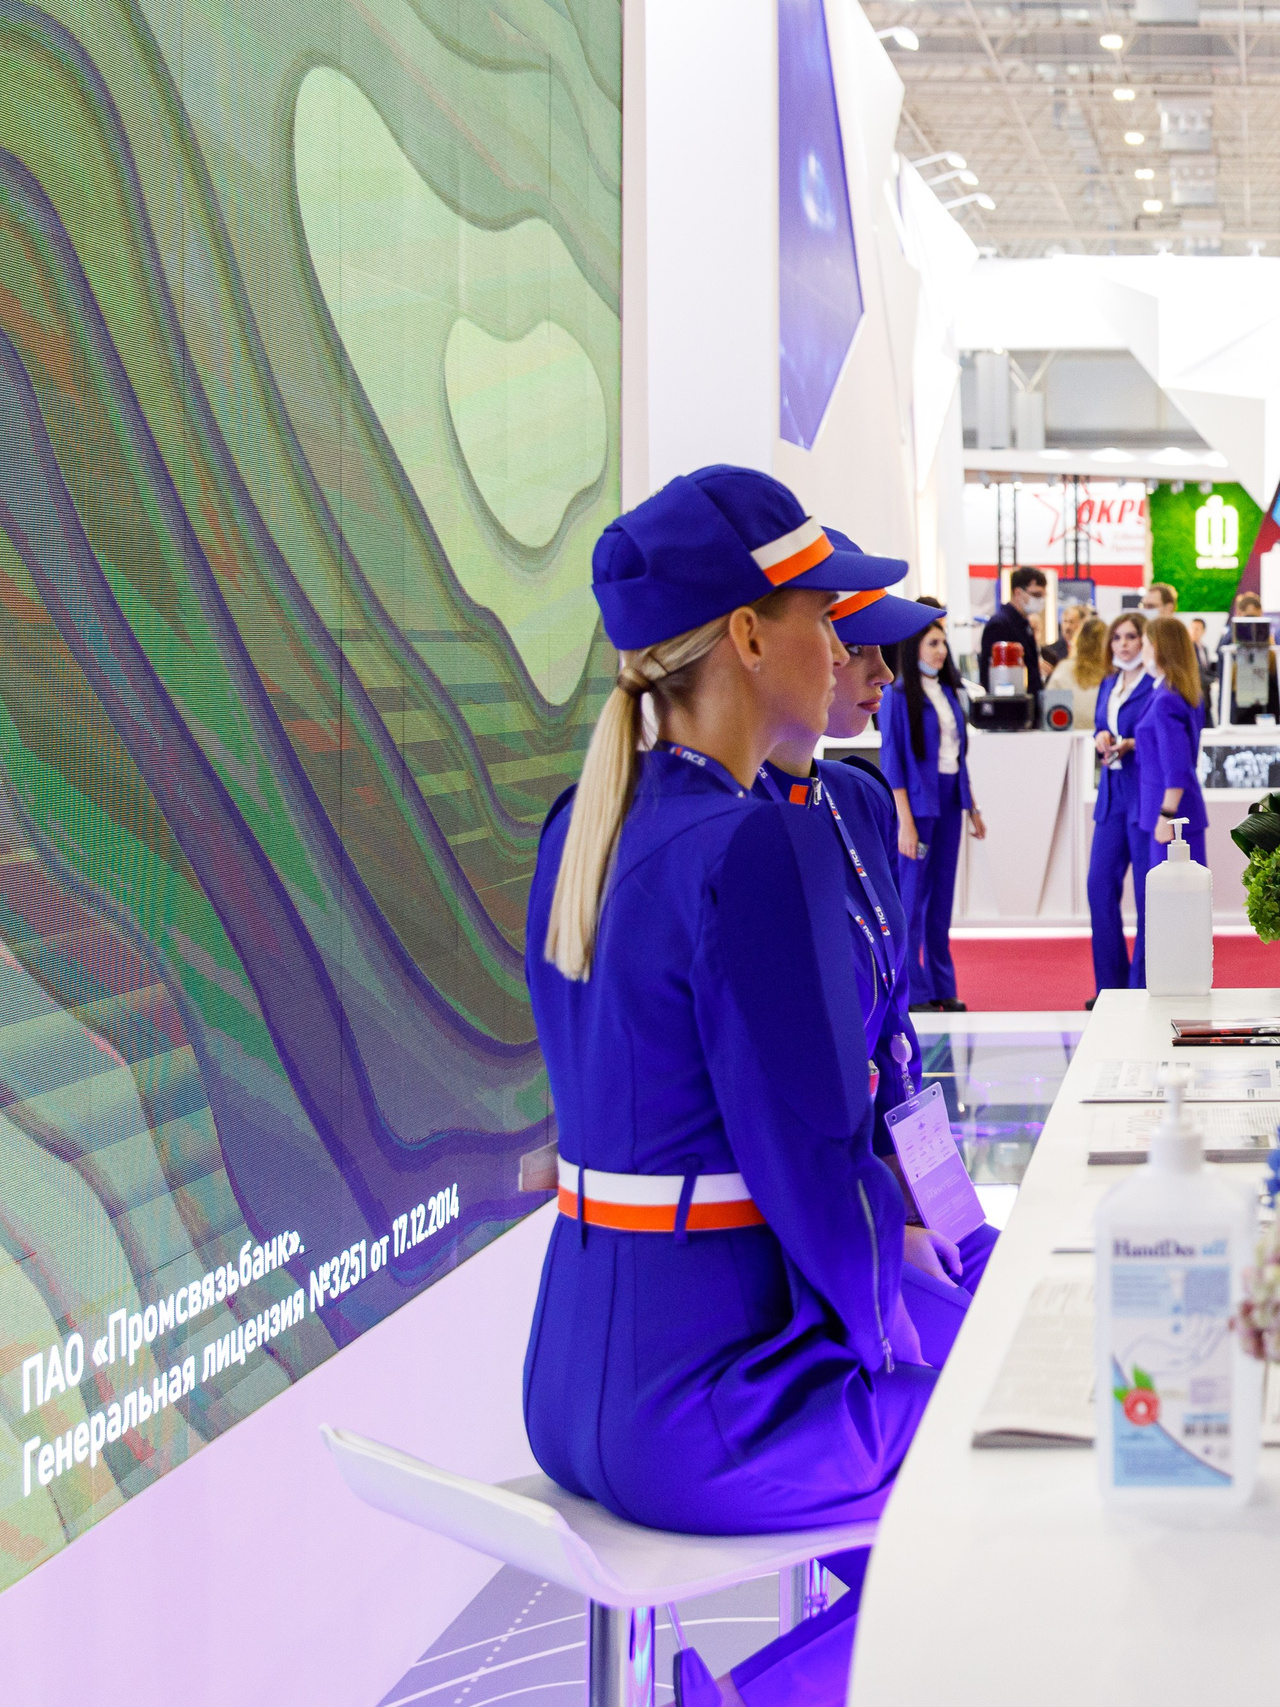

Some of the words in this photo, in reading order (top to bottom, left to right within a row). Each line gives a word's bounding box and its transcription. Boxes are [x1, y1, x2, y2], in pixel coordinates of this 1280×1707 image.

[682, 750, 707, 767] ПСБ
[875, 905, 886, 925] ПСБ
[22, 1332, 84, 1414] ПАО
[92, 1230, 305, 1366] «Промсвязьбанк».
[23, 1355, 196, 1497] Генеральная
[201, 1288, 304, 1382] лицензия
[309, 1239, 367, 1312] №3251
[370, 1235, 389, 1272] от
[392, 1182, 459, 1258] 17.12.2014
